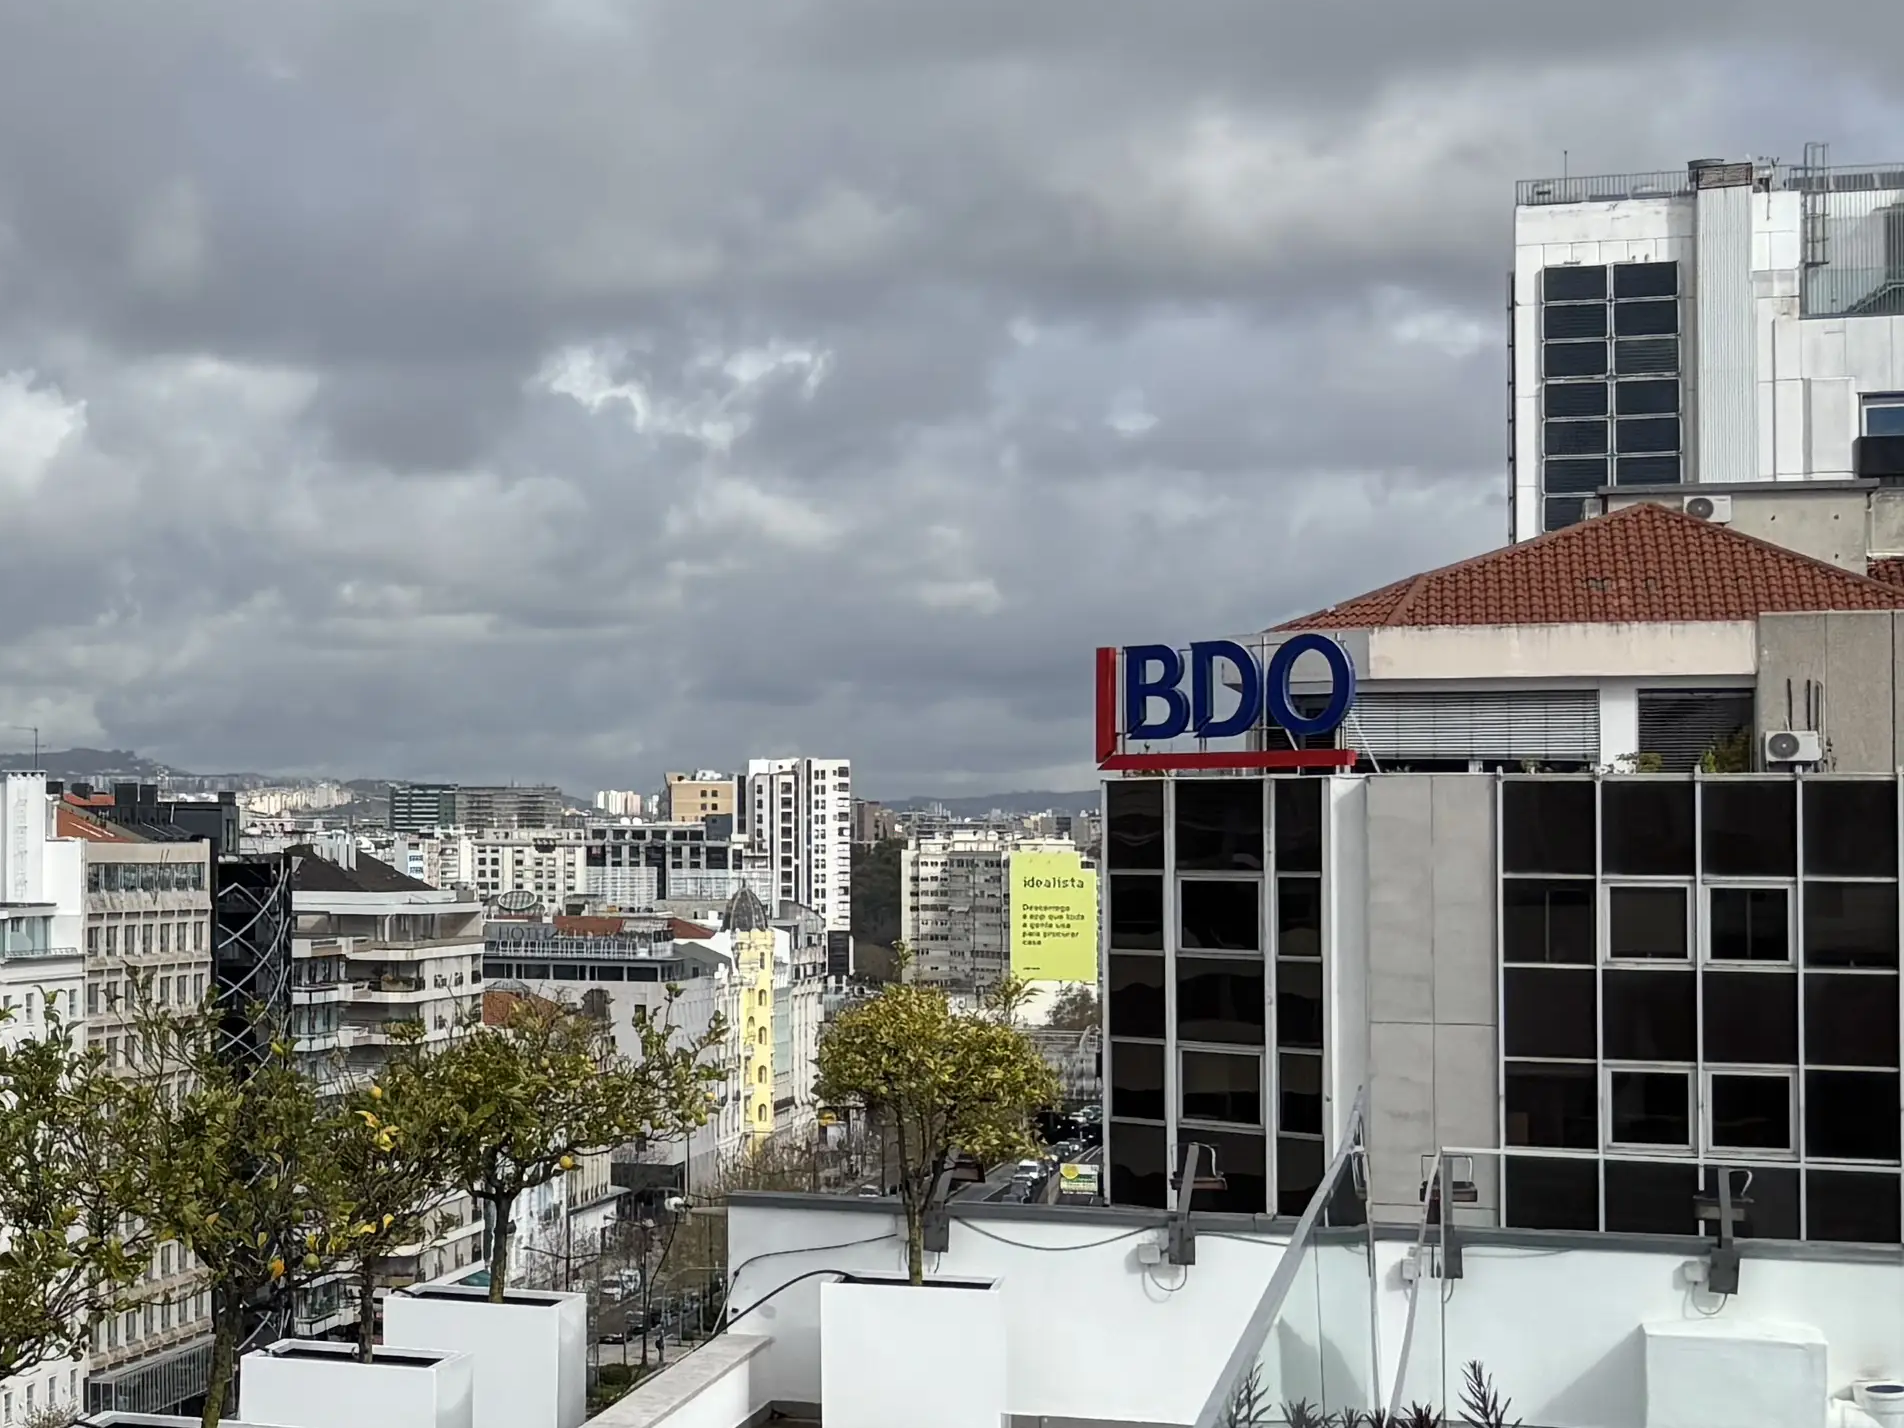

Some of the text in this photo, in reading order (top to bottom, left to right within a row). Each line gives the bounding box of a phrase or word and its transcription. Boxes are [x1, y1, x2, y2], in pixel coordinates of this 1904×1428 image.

[1123, 633, 1356, 740] BDO
[1023, 876, 1085, 889] idealista
[498, 924, 554, 941] HOTEL
